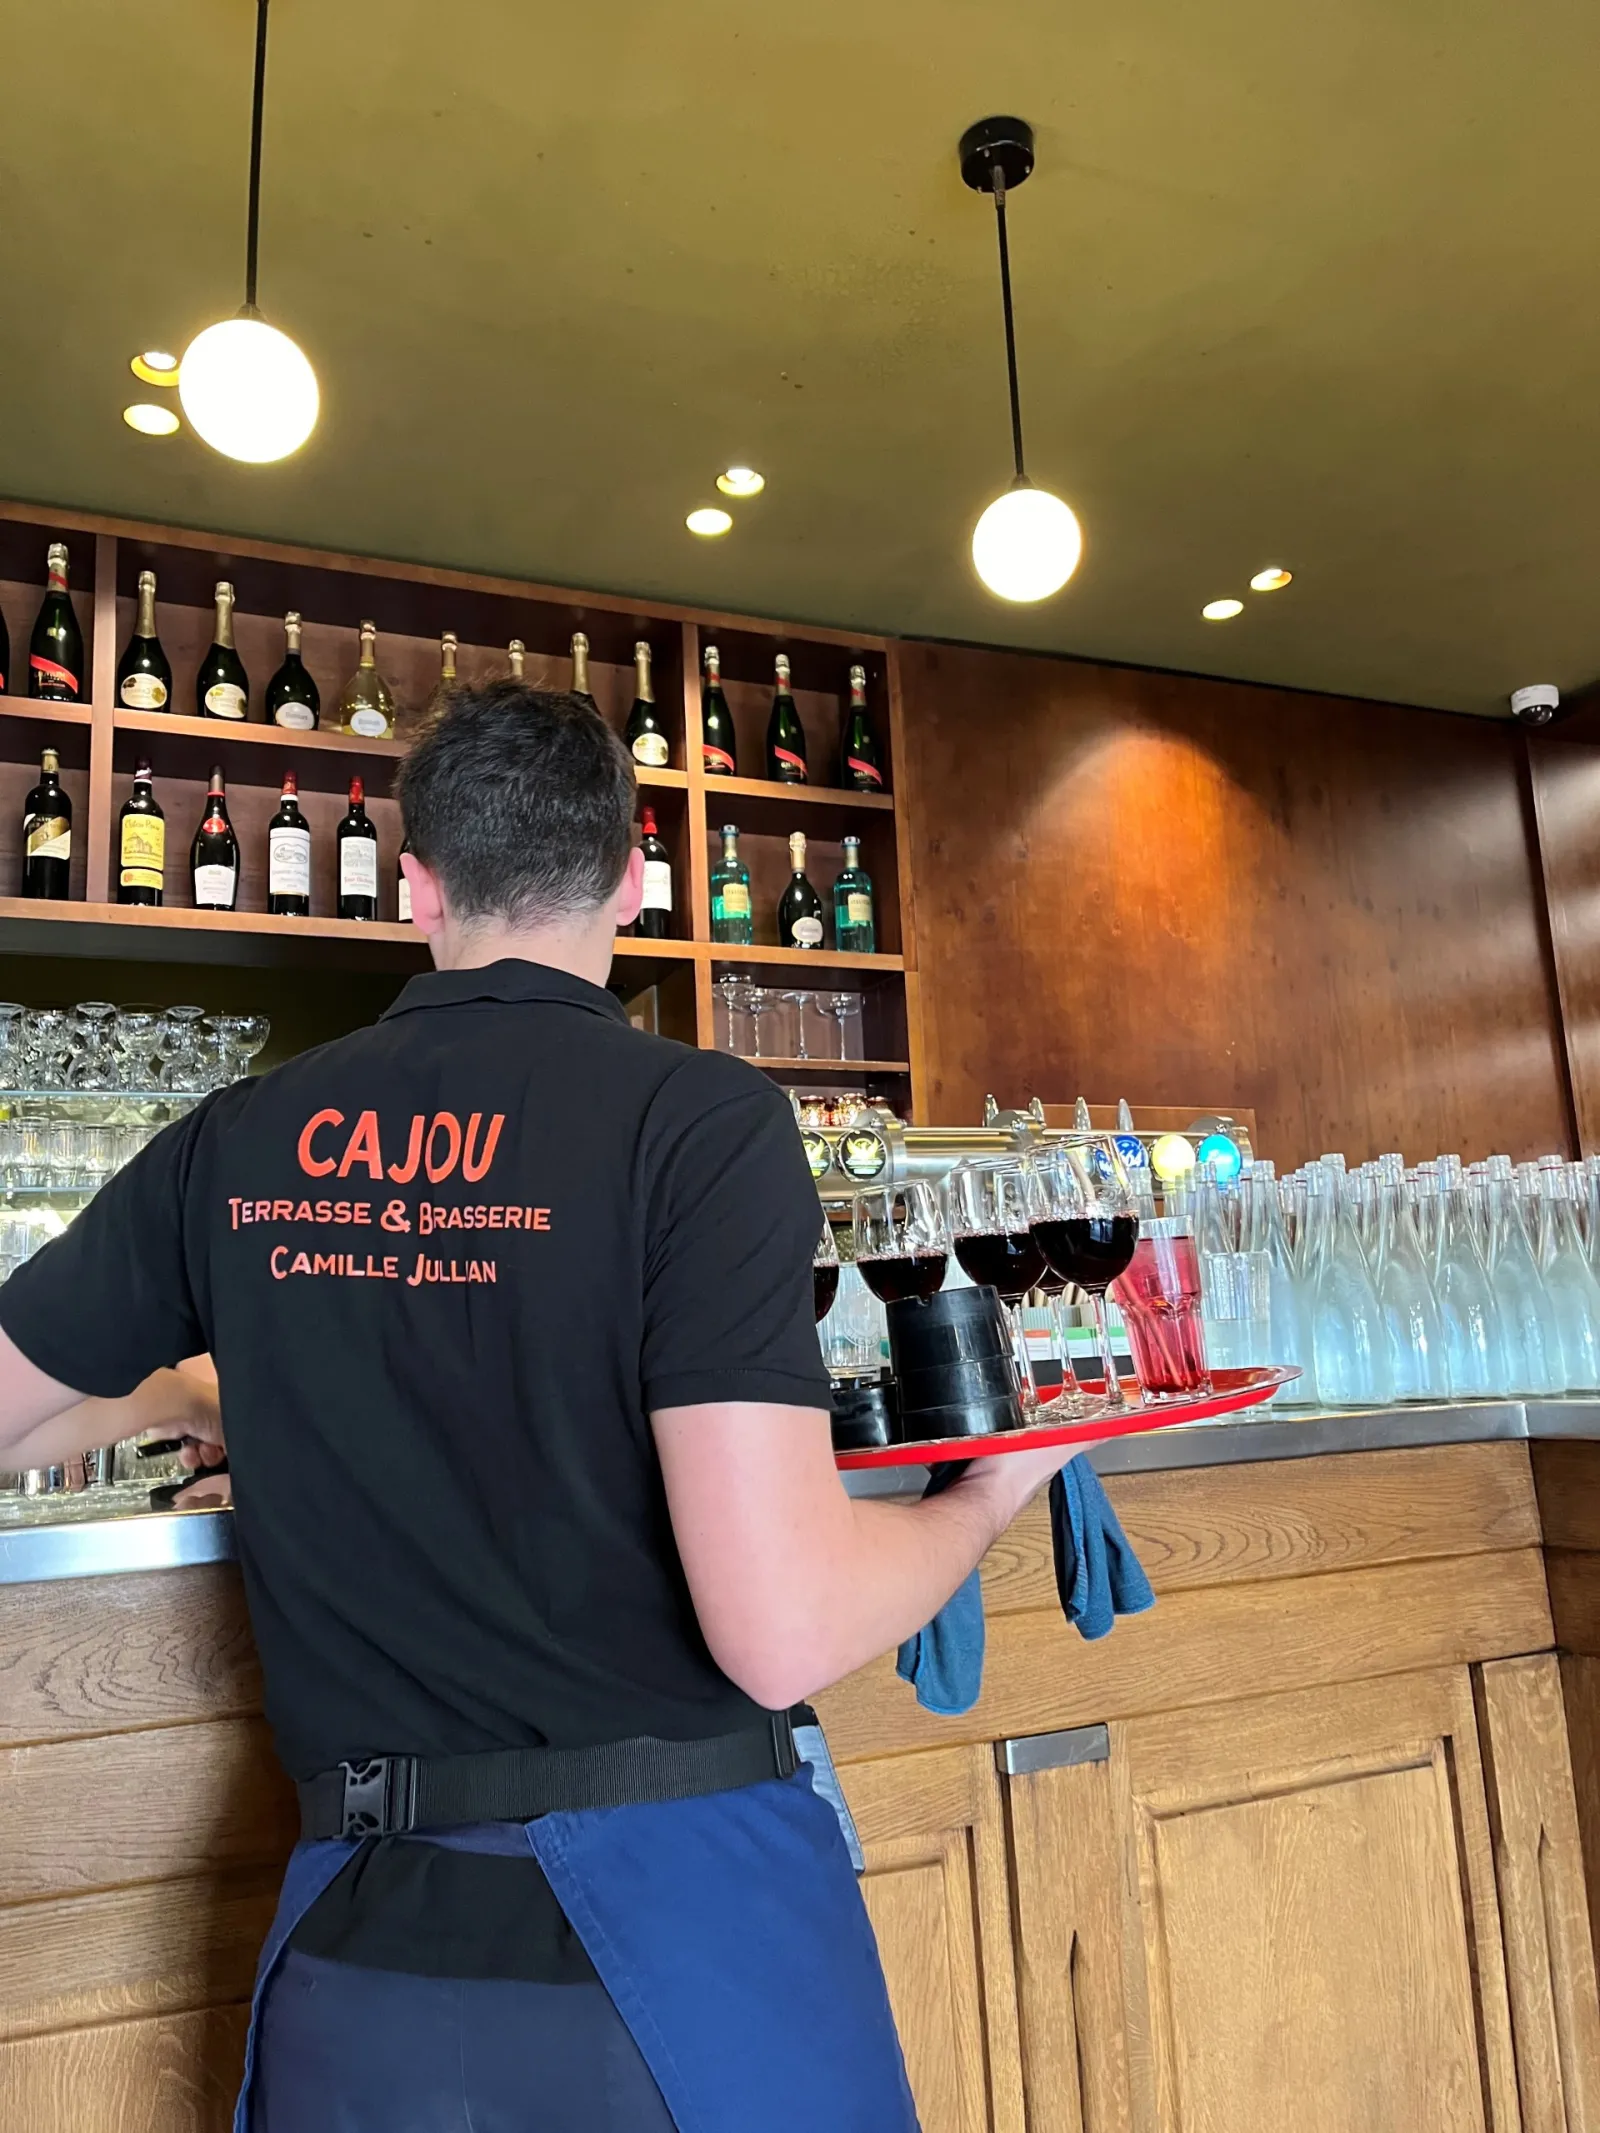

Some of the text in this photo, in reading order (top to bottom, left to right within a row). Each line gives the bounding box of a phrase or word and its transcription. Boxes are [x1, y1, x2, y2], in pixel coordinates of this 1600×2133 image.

[298, 1108, 505, 1184] CAJOU
[228, 1198, 551, 1235] TERRASSE & BRASSERIE
[270, 1246, 398, 1280] CAMILLE
